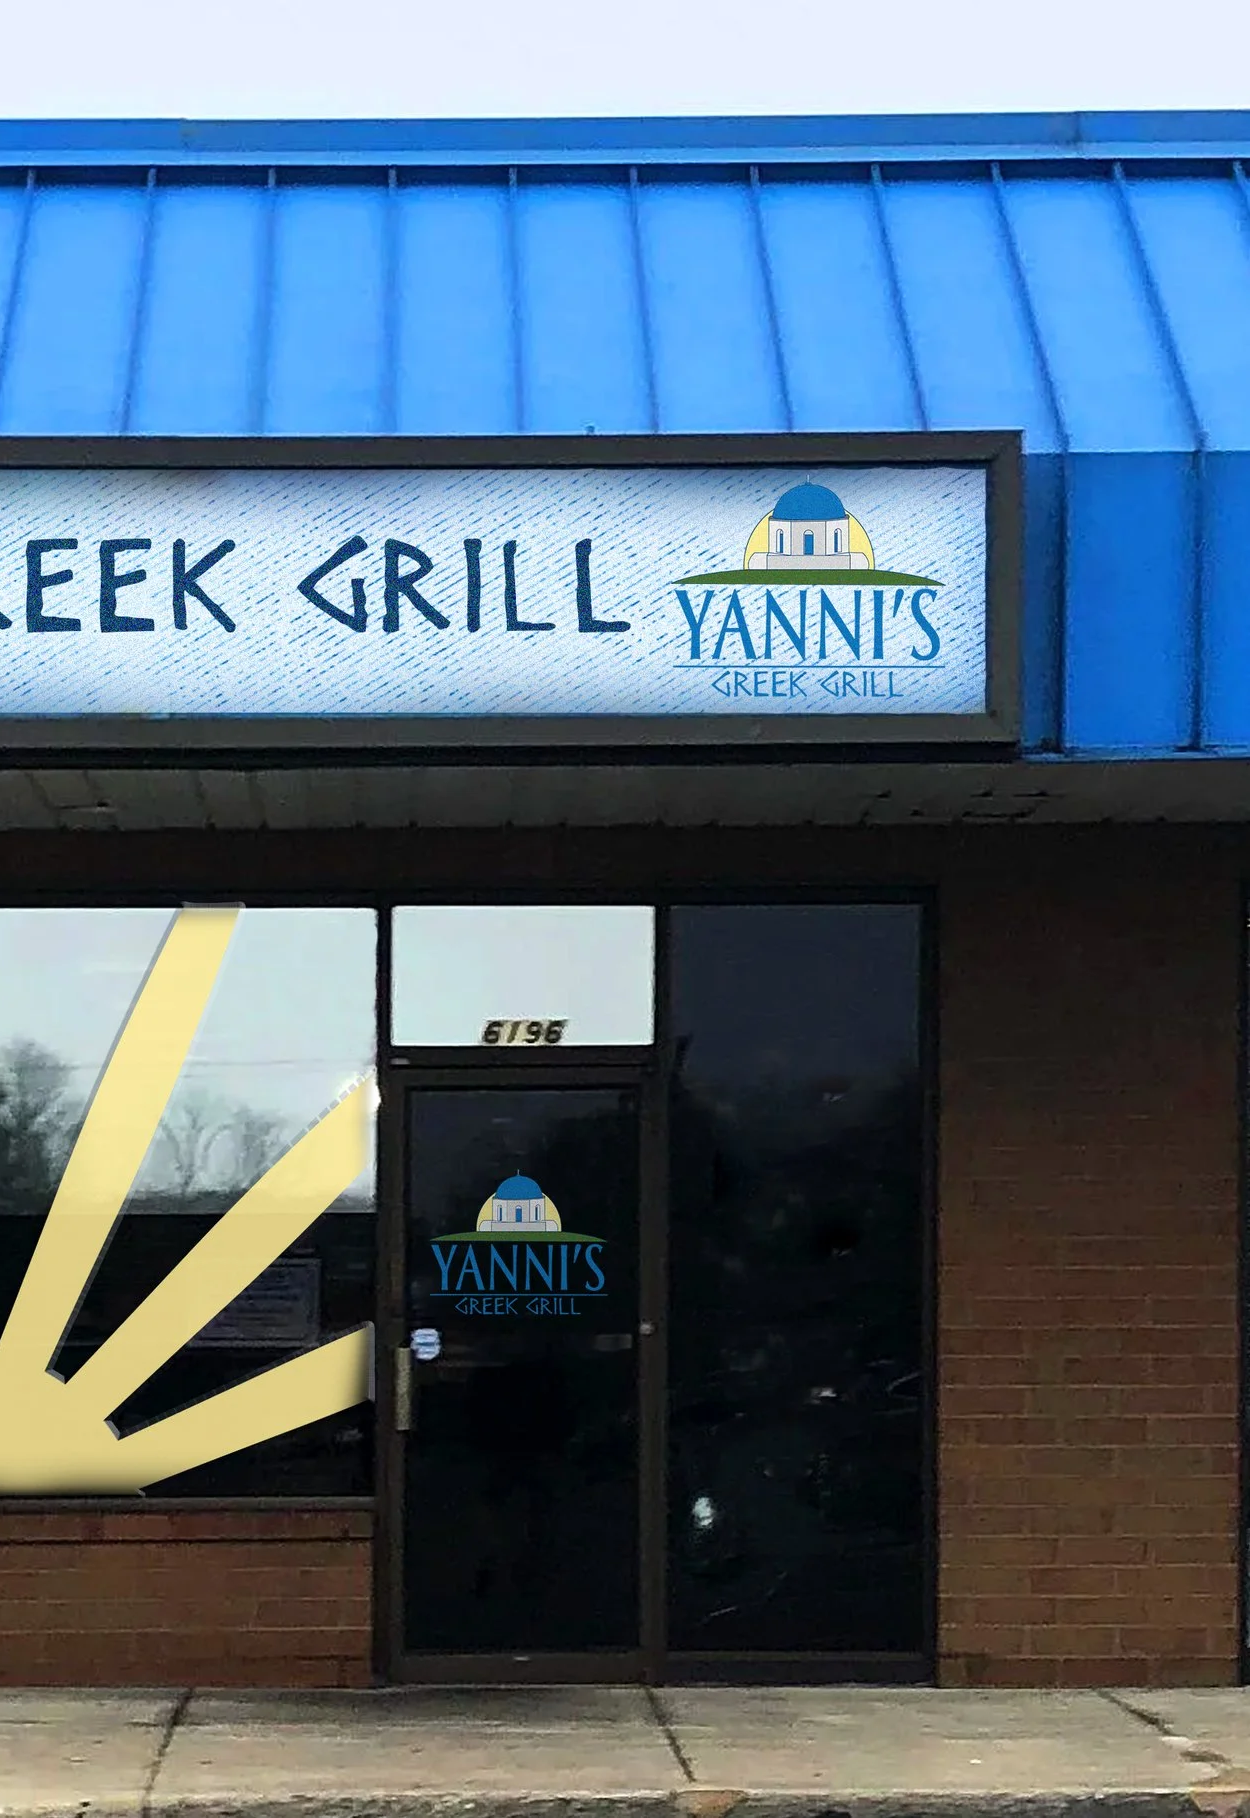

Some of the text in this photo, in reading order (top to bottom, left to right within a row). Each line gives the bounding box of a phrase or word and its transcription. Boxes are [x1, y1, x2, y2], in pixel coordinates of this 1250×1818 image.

[296, 535, 631, 633] GRILL
[674, 587, 941, 661] YANNI'S
[711, 670, 904, 698] GREEK GRILL
[482, 1019, 567, 1044] 6196
[430, 1243, 605, 1292] YANNI'S
[454, 1296, 581, 1315] GREEK GRILL
